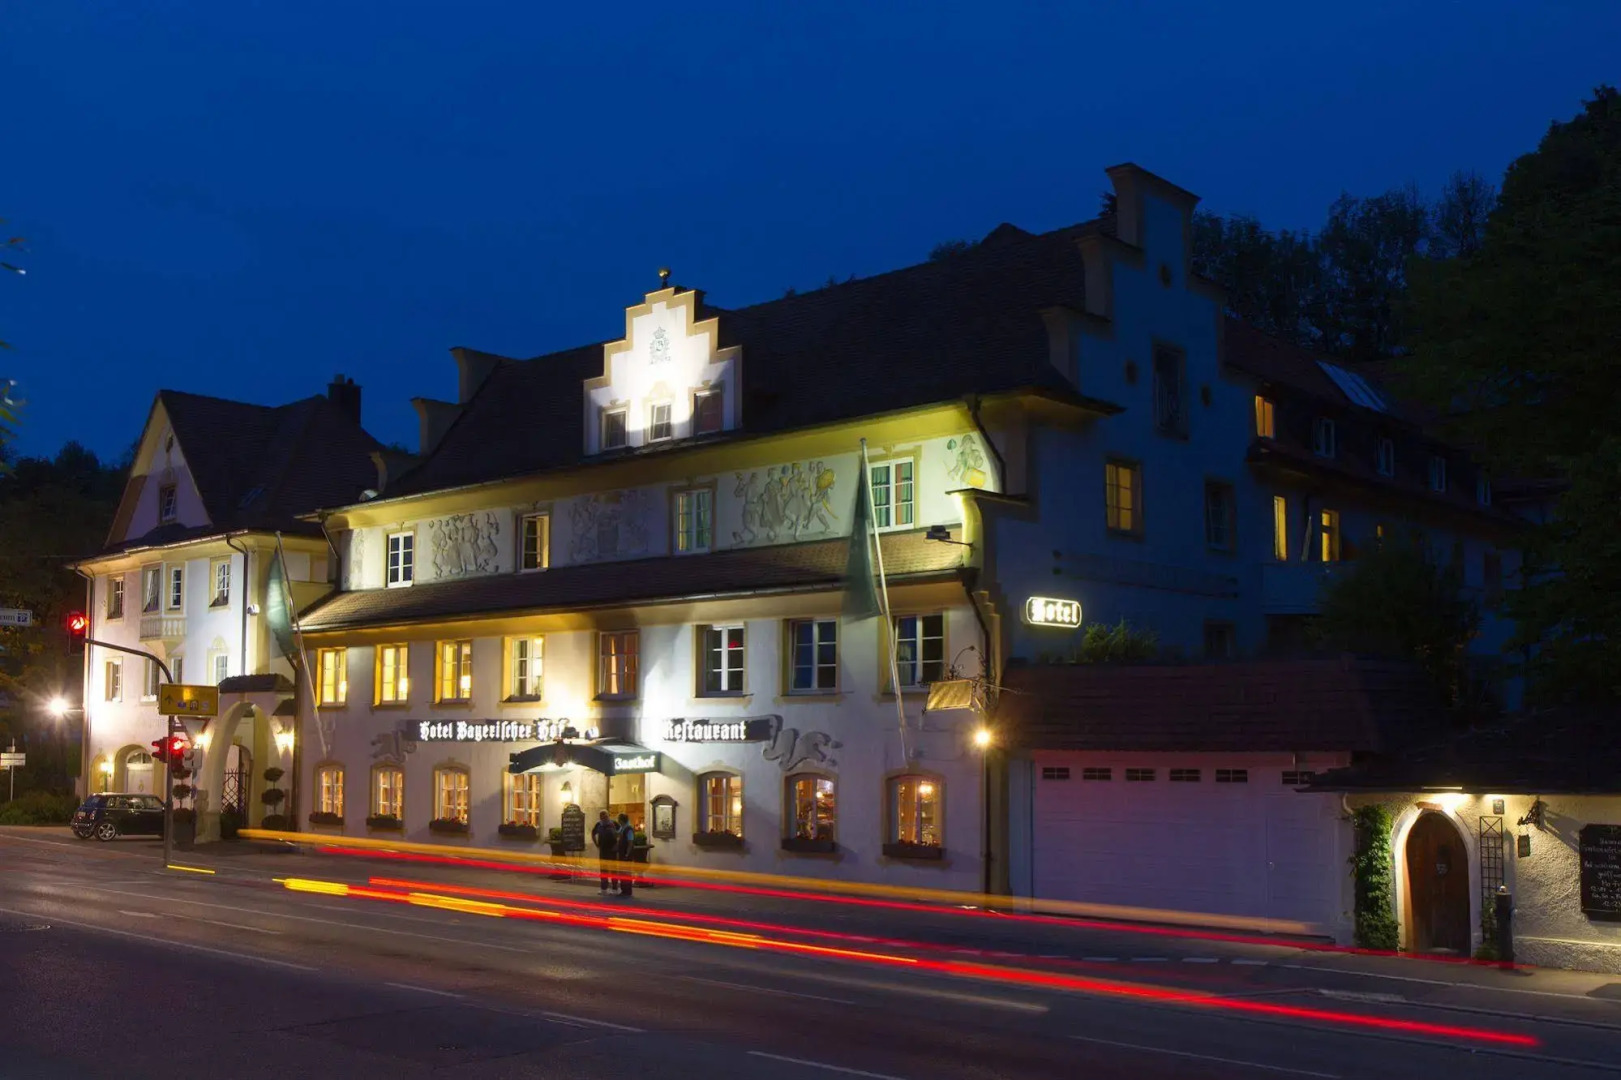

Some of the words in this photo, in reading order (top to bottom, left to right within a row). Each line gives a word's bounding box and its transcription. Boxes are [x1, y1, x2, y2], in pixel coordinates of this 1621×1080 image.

[1032, 599, 1078, 623] Hotel
[420, 720, 453, 741] Hotel
[615, 755, 656, 770] Gasthof
